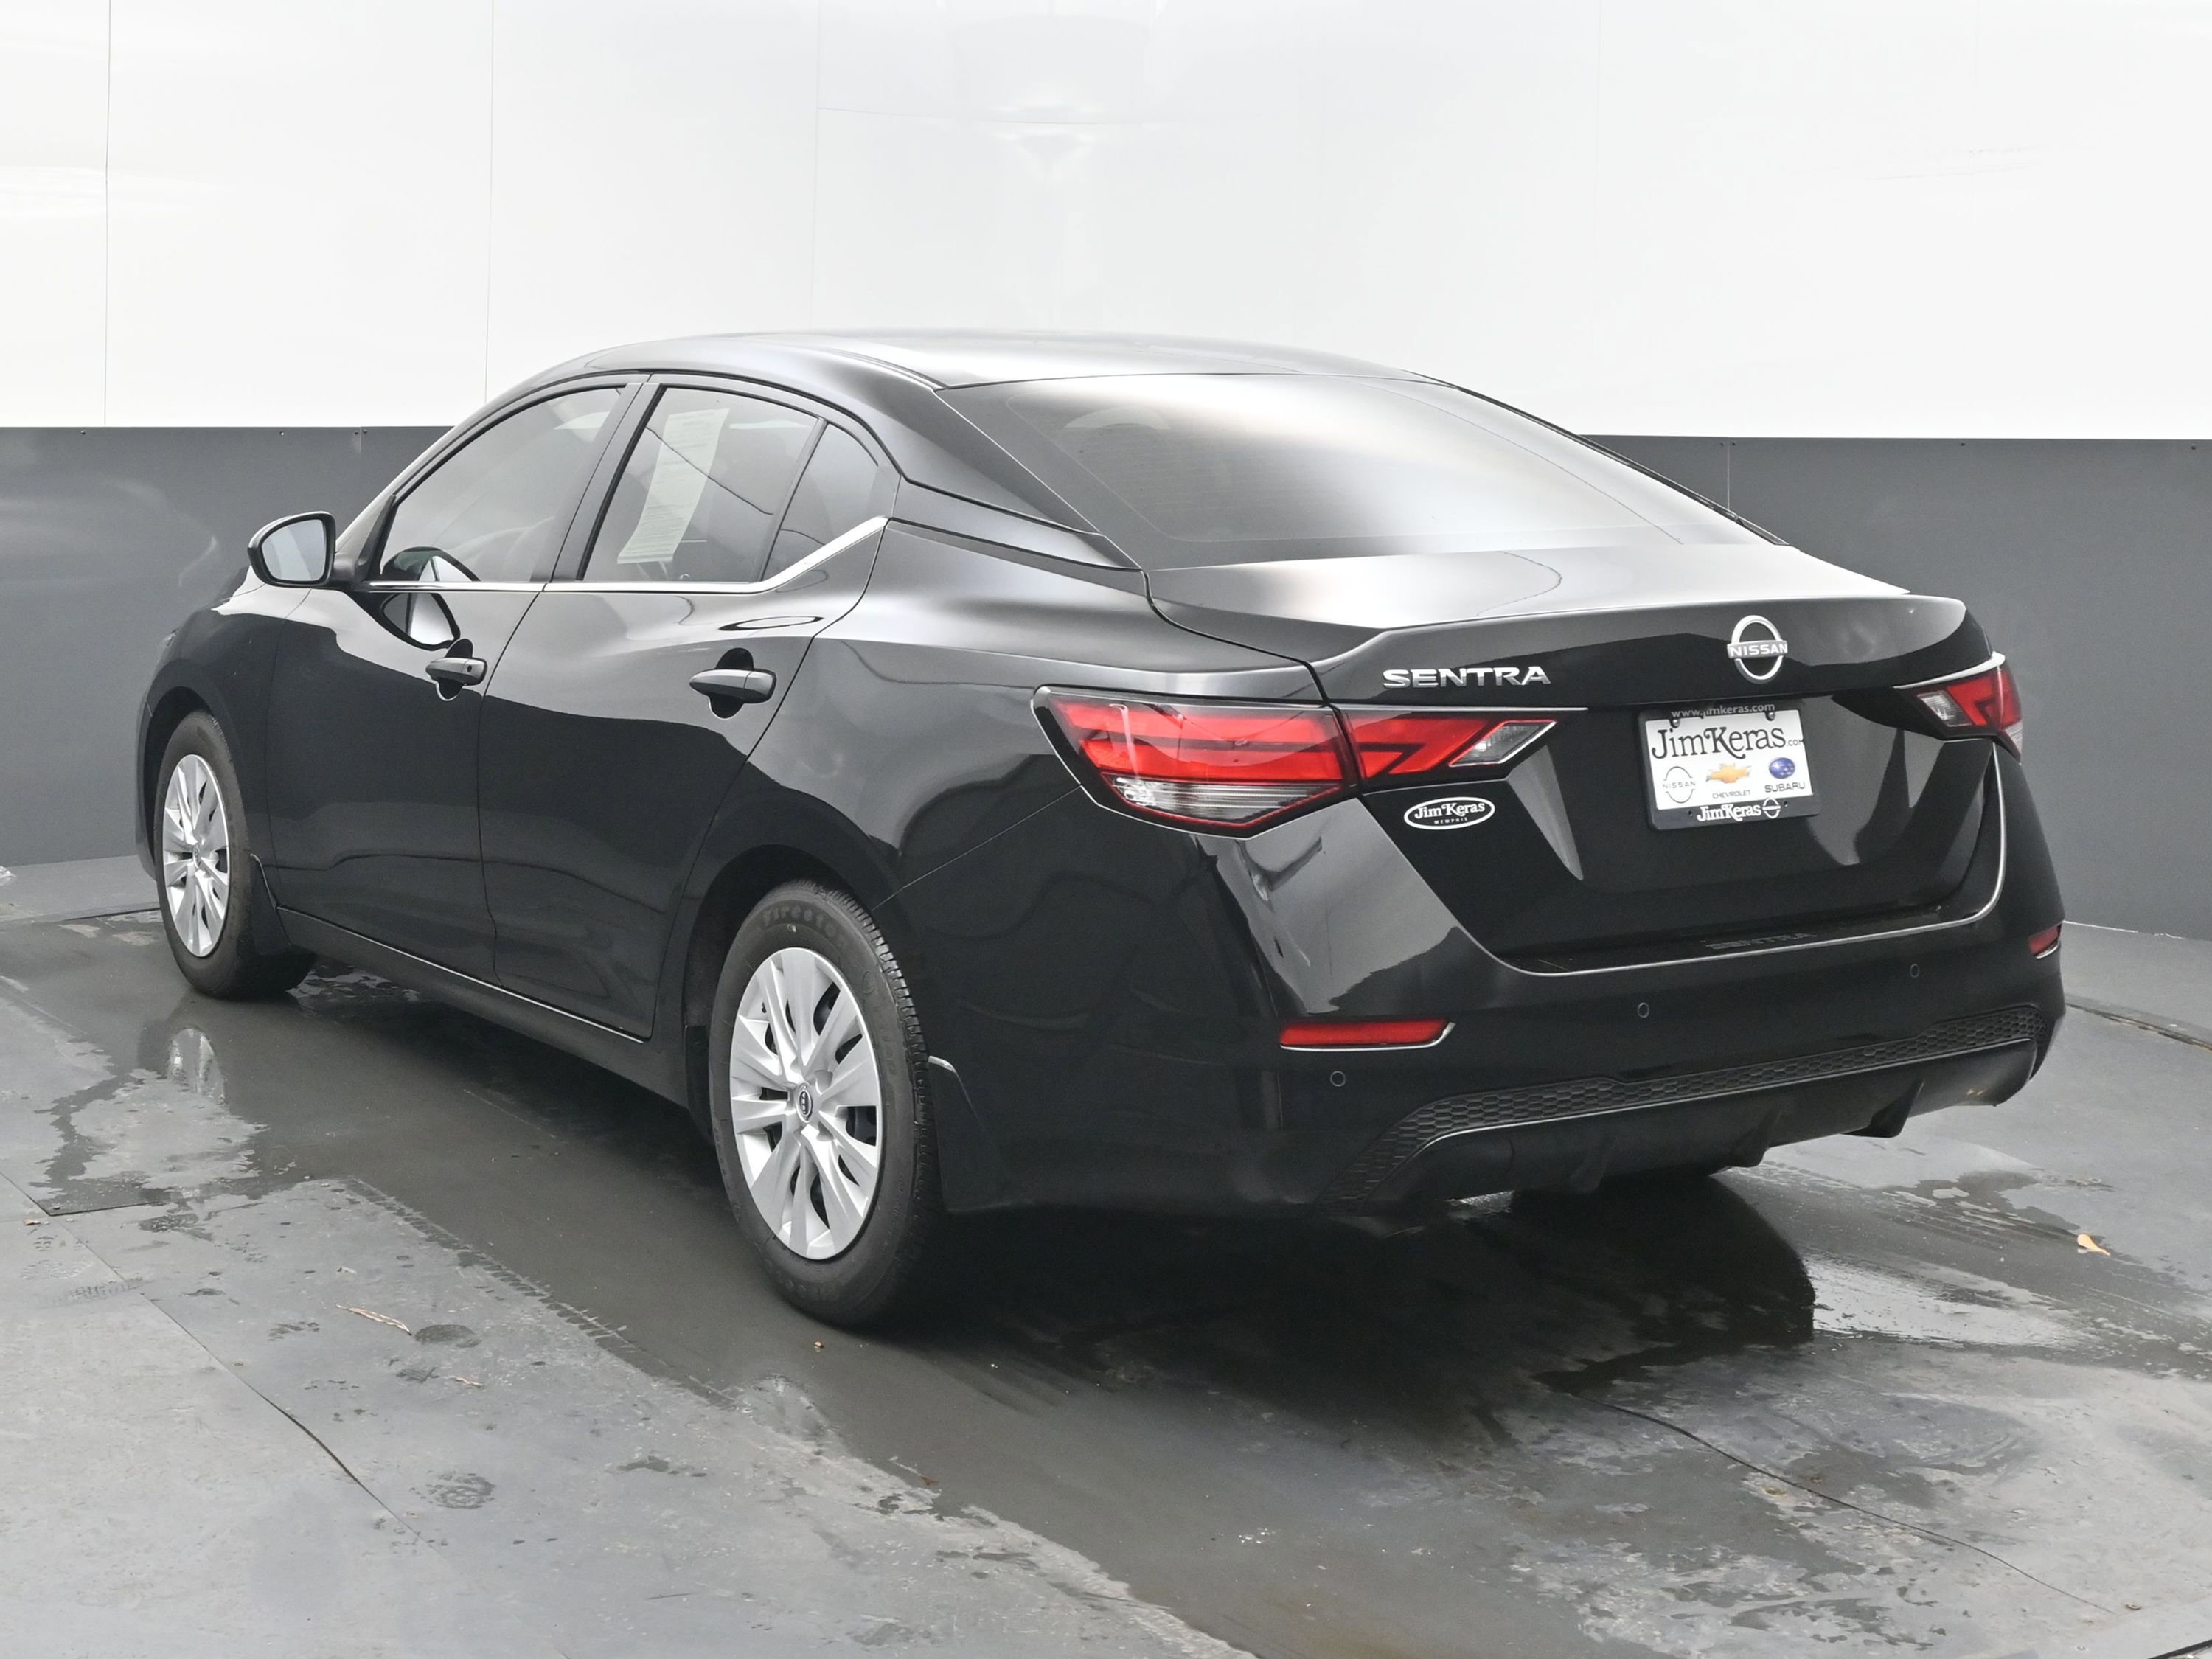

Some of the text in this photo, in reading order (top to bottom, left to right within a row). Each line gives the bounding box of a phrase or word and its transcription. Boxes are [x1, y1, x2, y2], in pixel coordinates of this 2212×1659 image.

[1729, 642, 1788, 658] NISSAN
[1382, 666, 1551, 689] SENTRA
[1671, 703, 1775, 718] www.jimkeras.com
[1662, 780, 1696, 789] NISSAN
[1764, 782, 1806, 793] SUBARU
[1712, 789, 1751, 799] CHEVROLET
